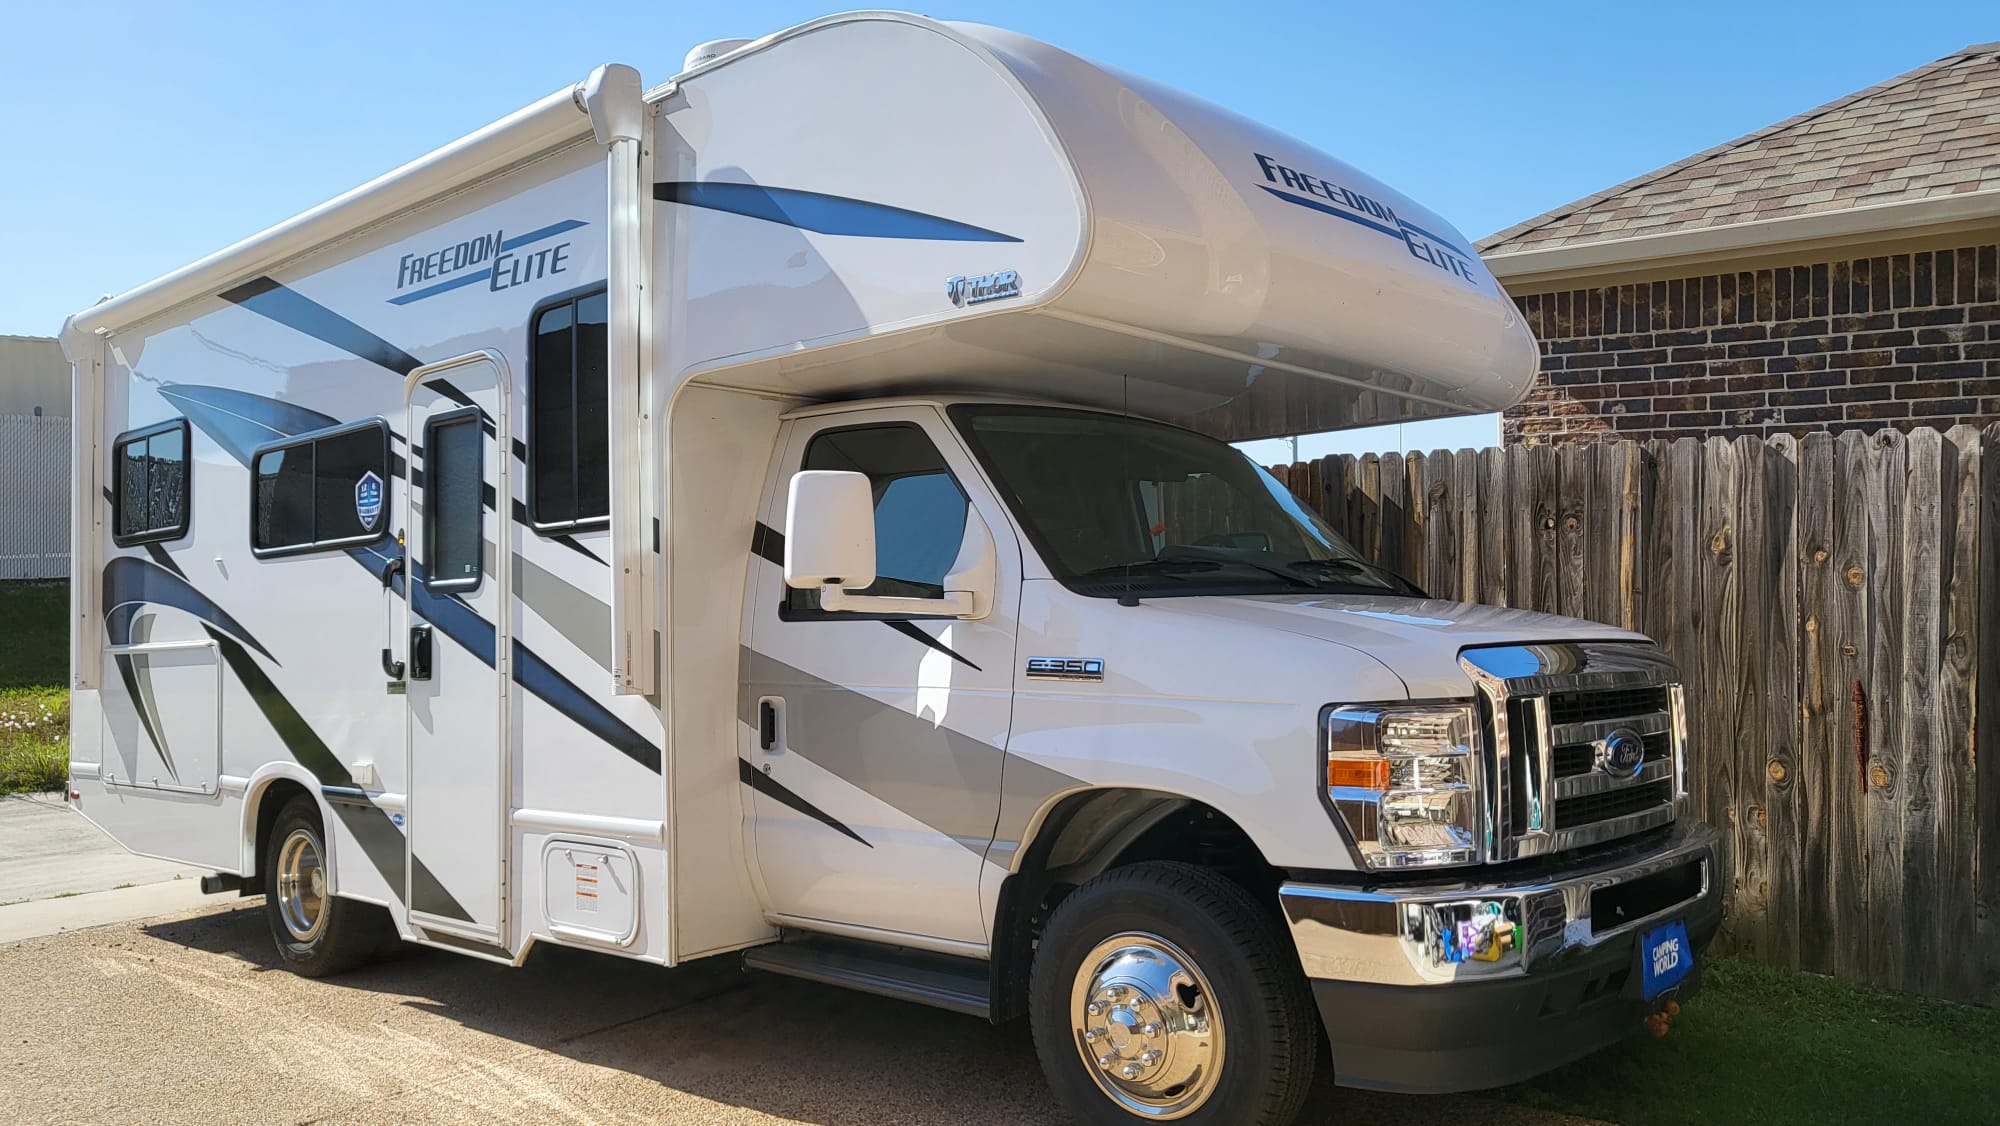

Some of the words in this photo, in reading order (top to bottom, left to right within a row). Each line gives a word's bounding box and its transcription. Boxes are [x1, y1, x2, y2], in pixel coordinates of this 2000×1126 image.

[1254, 152, 1400, 227] FREEDOM
[397, 230, 503, 289] FREEDOM
[490, 243, 570, 292] ELITE
[1400, 228, 1478, 285] ELITE
[967, 270, 1019, 297] THOR
[1653, 938, 1679, 961] CAMPING
[1653, 952, 1679, 978] WORLD
